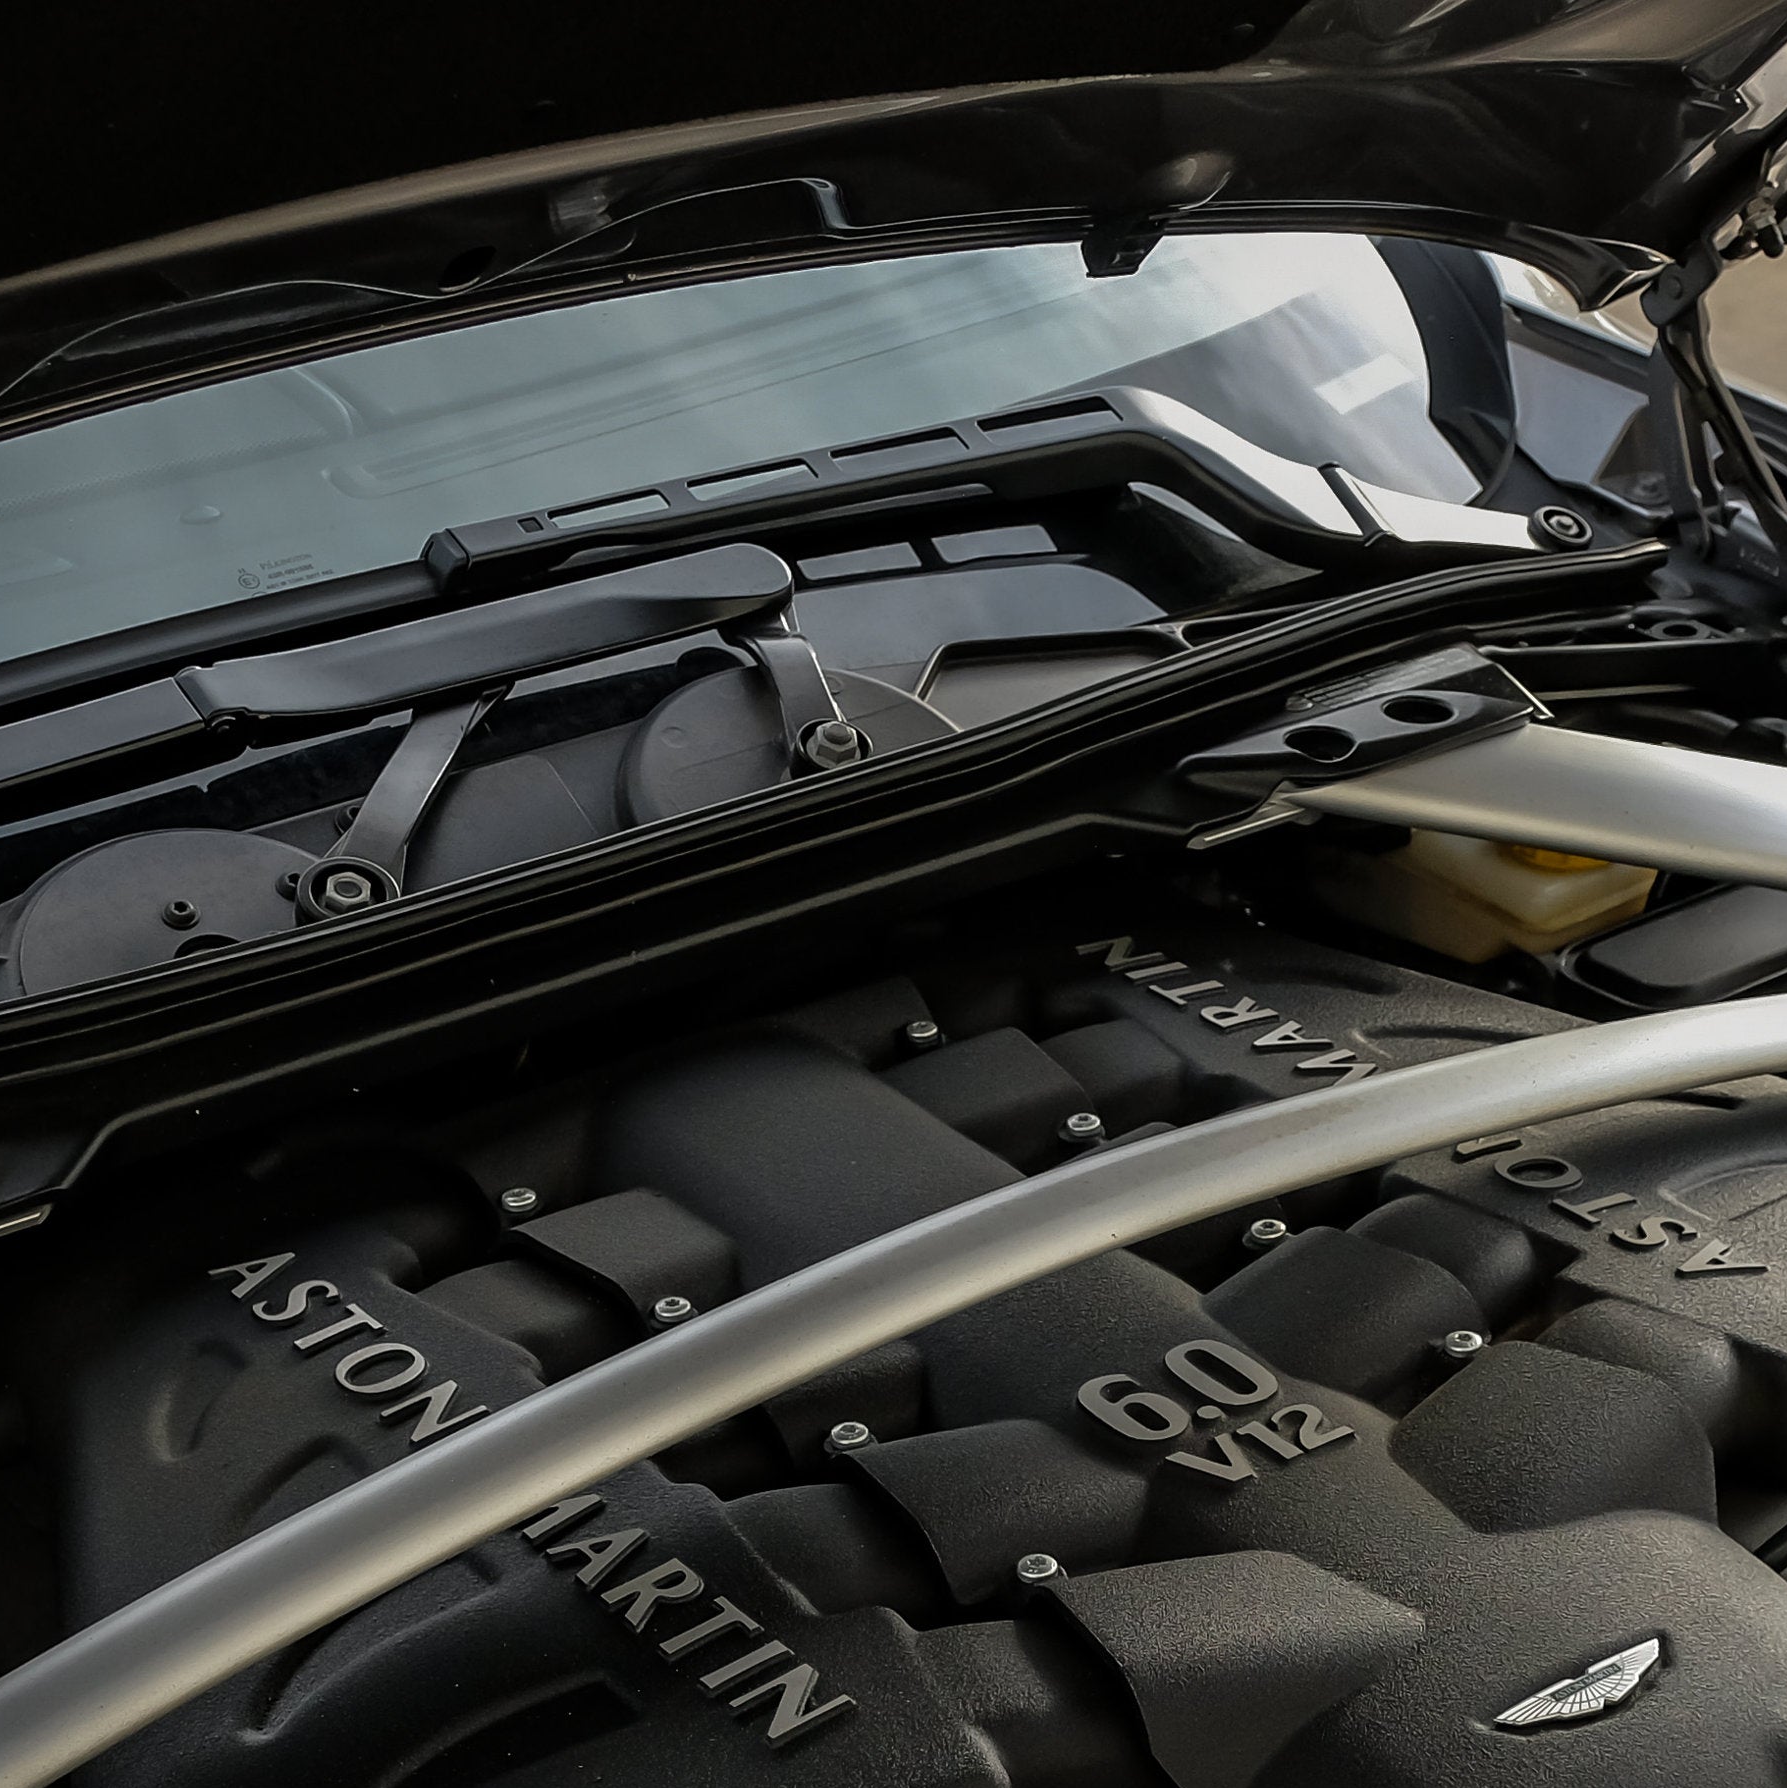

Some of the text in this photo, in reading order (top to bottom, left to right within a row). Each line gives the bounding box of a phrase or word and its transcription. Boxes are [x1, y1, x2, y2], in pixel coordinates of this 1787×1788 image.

[208, 1251, 491, 1447] ASTON
[1077, 1339, 1279, 1442] 6.0
[1165, 1402, 1357, 1482] V12
